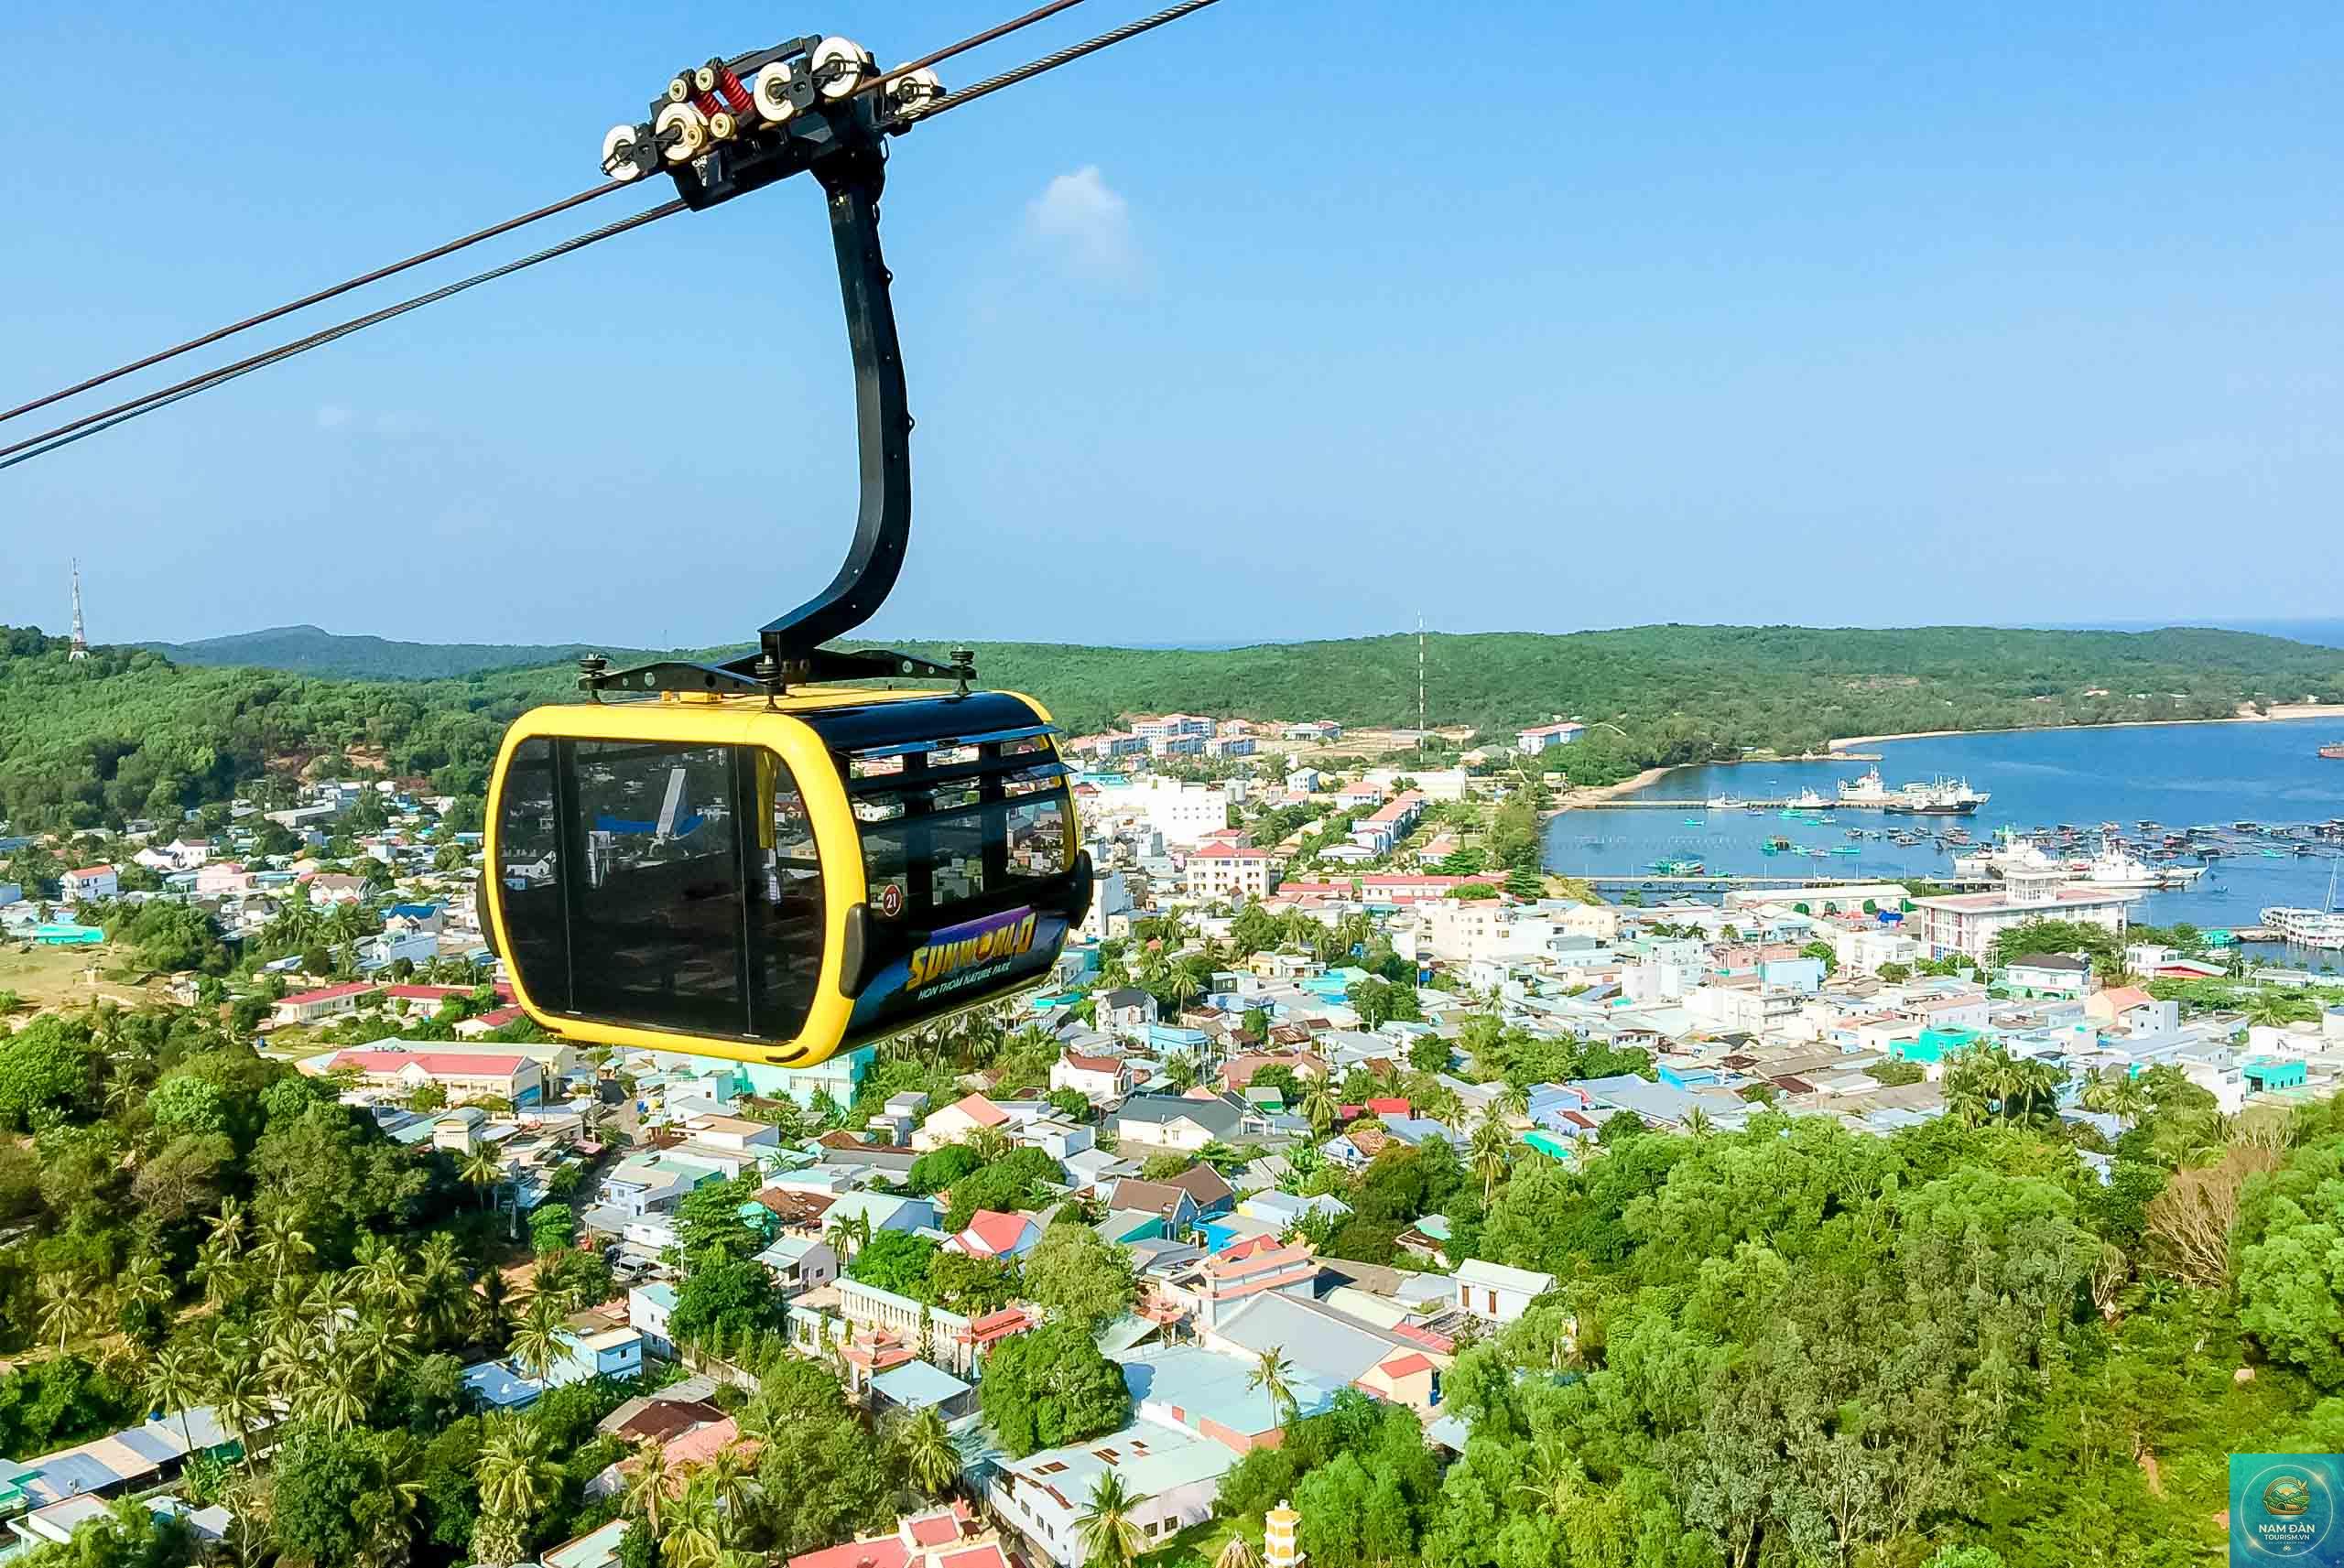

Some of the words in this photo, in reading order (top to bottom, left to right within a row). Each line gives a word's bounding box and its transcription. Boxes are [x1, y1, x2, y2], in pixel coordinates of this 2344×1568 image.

[885, 893, 897, 908] 21
[917, 984, 939, 1001] HON
[939, 975, 964, 992] THOM
